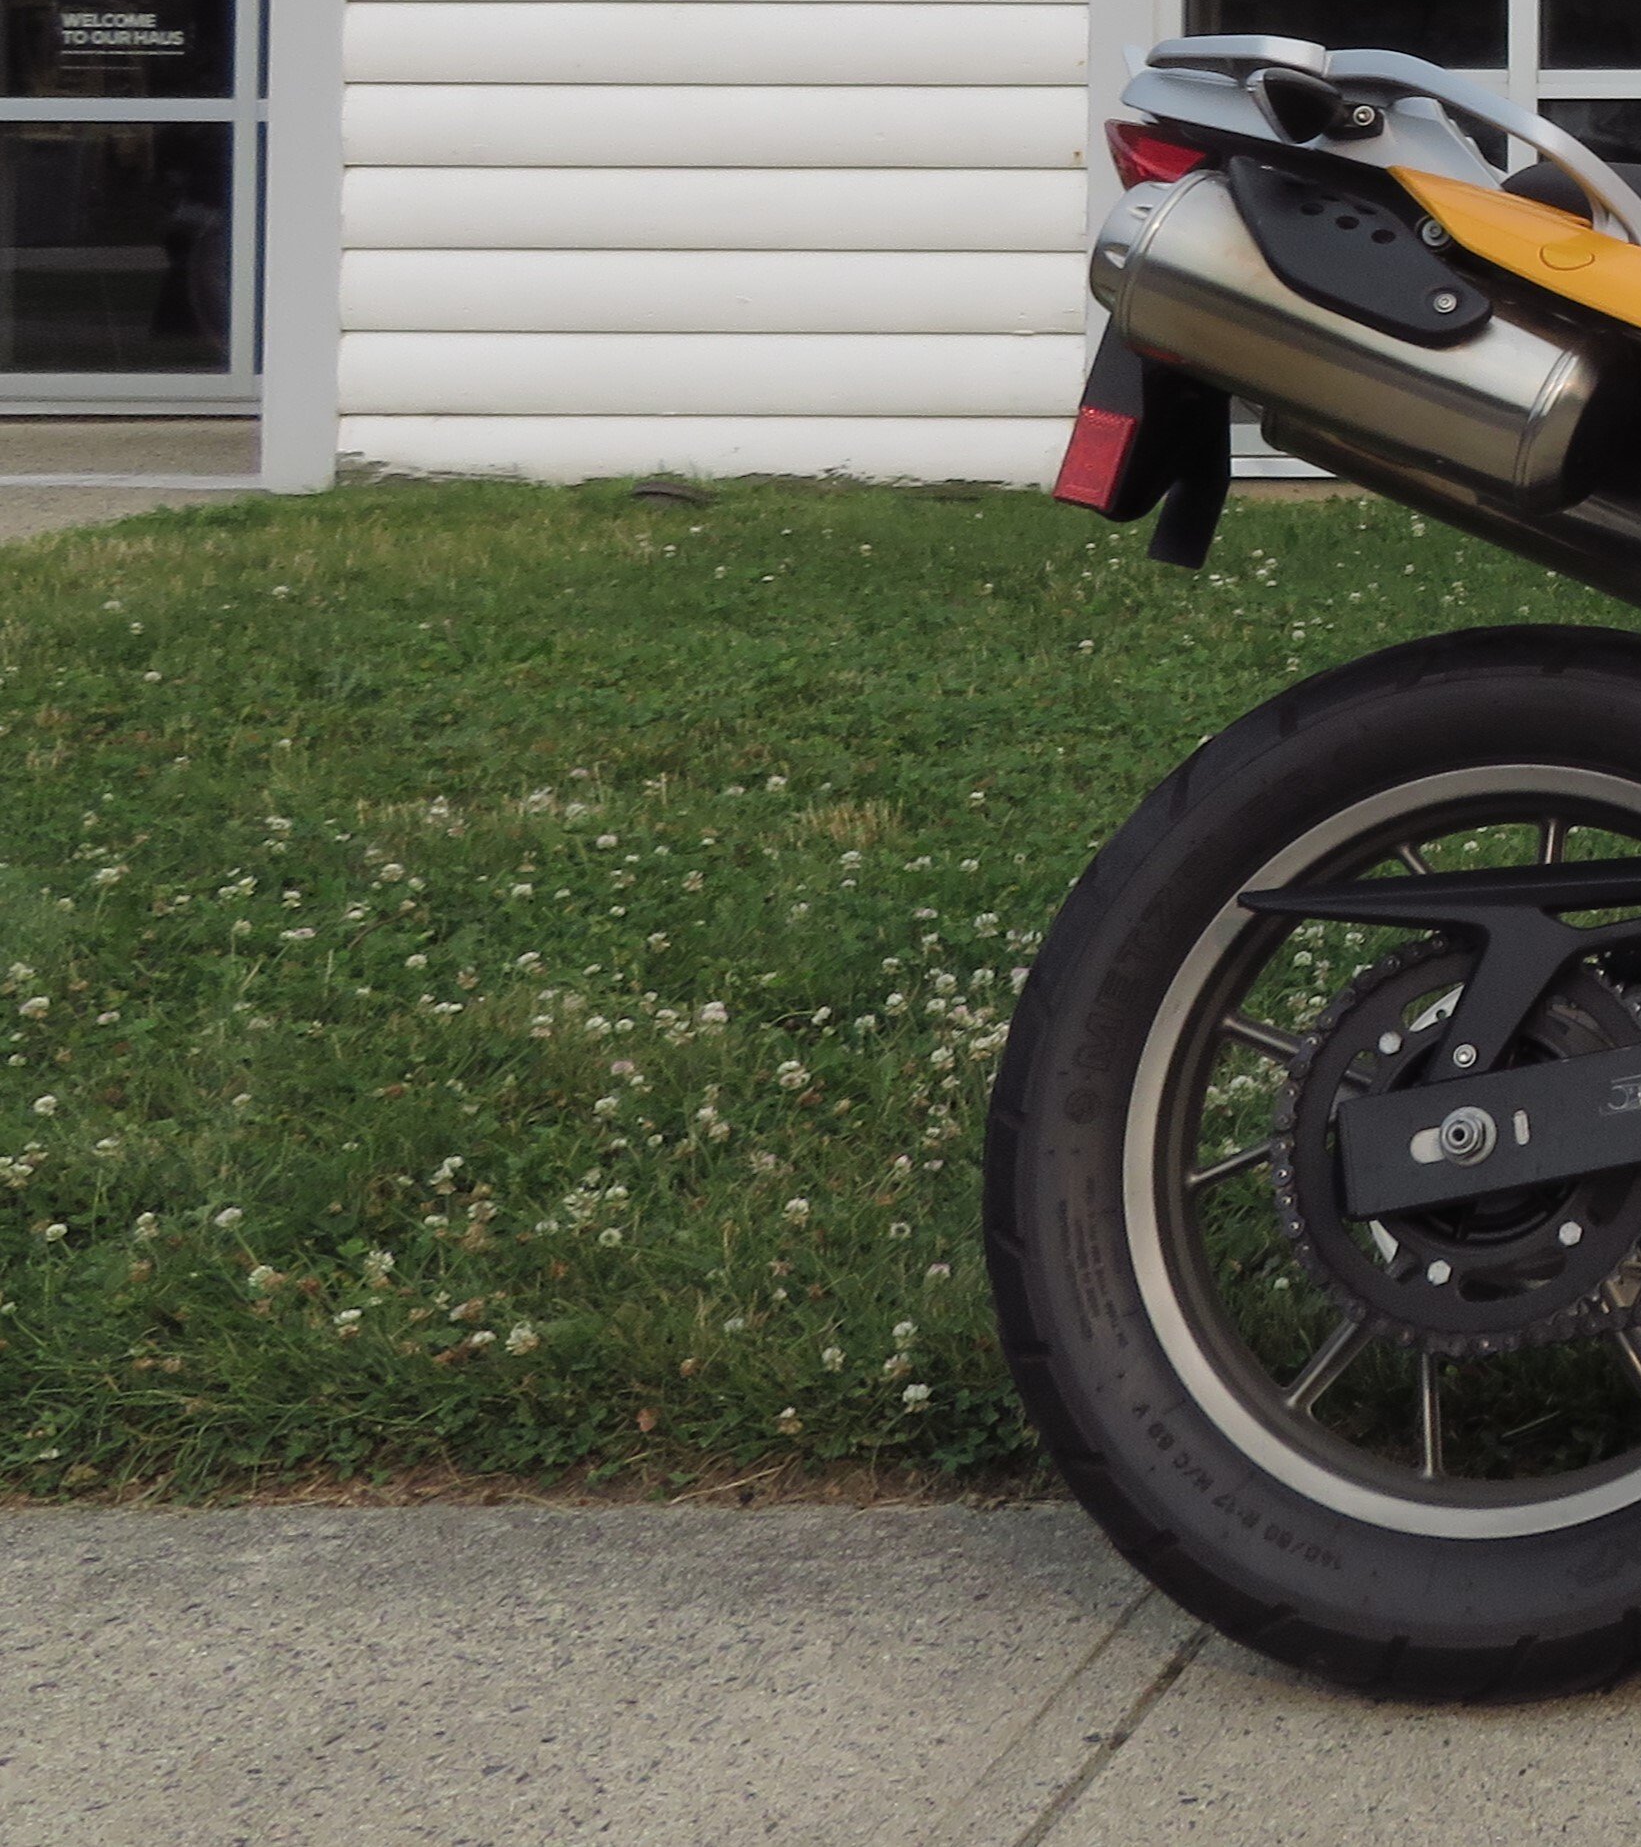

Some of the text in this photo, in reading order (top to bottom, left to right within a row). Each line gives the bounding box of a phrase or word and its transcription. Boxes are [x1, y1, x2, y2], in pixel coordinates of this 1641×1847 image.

[61, 13, 157, 28] WELCOME
[61, 30, 185, 46] TO OUR HAUS
